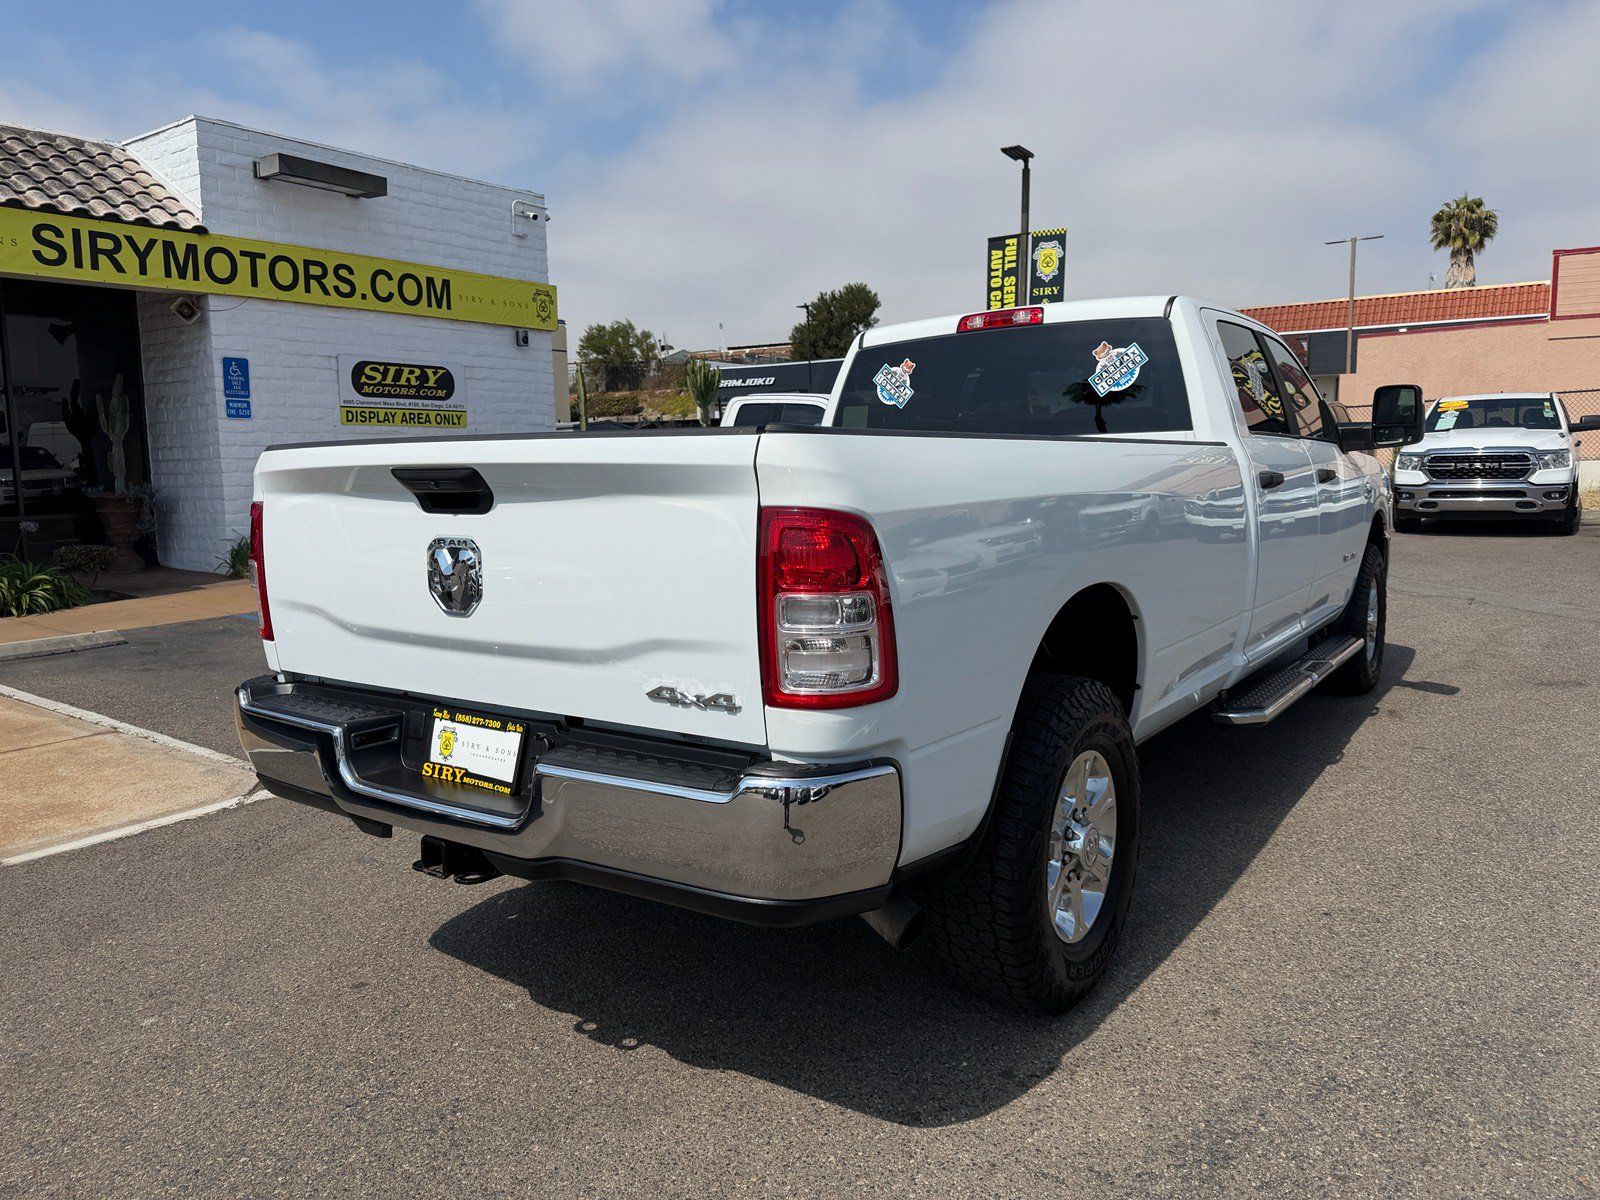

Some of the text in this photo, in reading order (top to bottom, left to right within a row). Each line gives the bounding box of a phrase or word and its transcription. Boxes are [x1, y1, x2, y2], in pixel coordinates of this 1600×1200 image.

[1004, 237, 1017, 271] FULL
[31, 223, 452, 311] SIRYMOTORS.COM
[990, 250, 1003, 288] AUTO
[1032, 286, 1060, 297] SIRY
[458, 294, 483, 304] SIRY
[502, 300, 529, 310] SONS
[360, 364, 447, 387] SIRY
[1094, 349, 1138, 384] CARFAX
[1106, 355, 1142, 386] OWNER
[361, 385, 448, 397] MOTORS.COM
[345, 409, 463, 425] DISPLAY AREA ONLY
[436, 538, 468, 547] RAM
[455, 712, 472, 723] (858)
[472, 716, 501, 729] 277-7300
[461, 741, 481, 750] SIRY
[495, 747, 517, 758] SONS
[421, 762, 512, 795] SIRY MOTORS.COM
